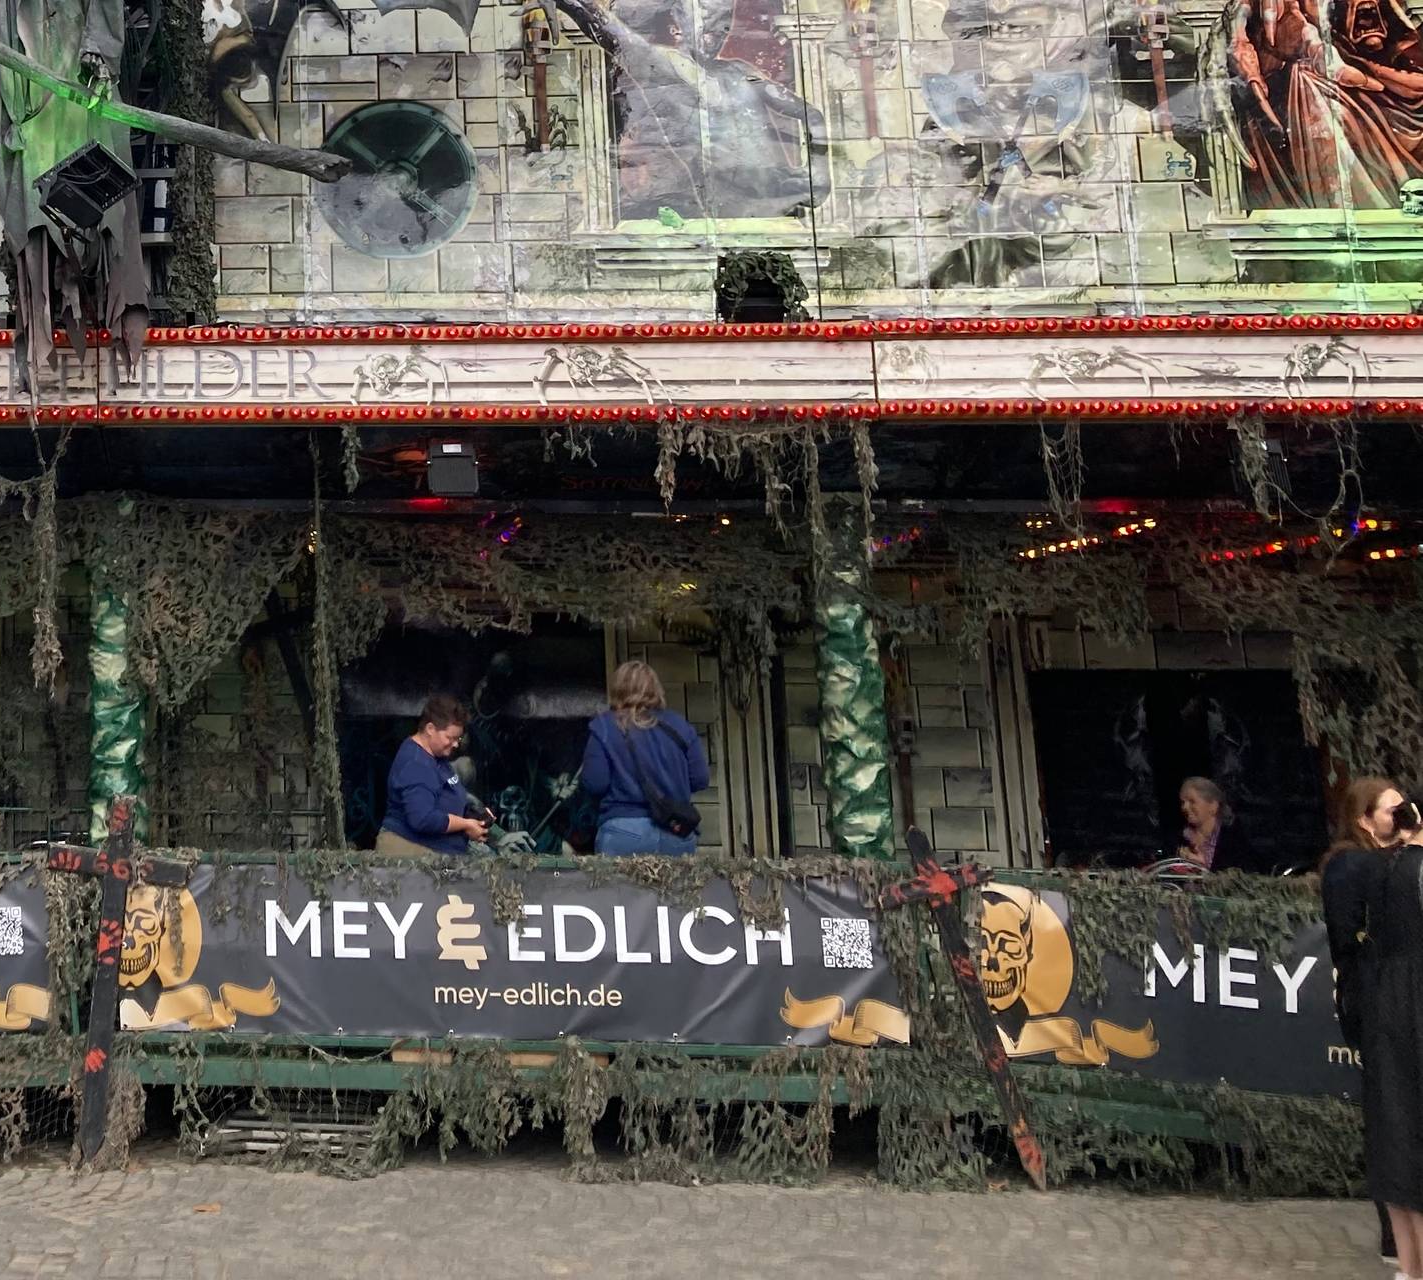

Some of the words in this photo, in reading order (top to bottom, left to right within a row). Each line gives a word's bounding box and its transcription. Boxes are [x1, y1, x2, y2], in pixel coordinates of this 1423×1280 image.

[265, 900, 423, 959] MEY
[507, 905, 794, 966] EDLICH
[434, 983, 622, 1010] mey-edlich.de
[1144, 942, 1318, 1013] MEY
